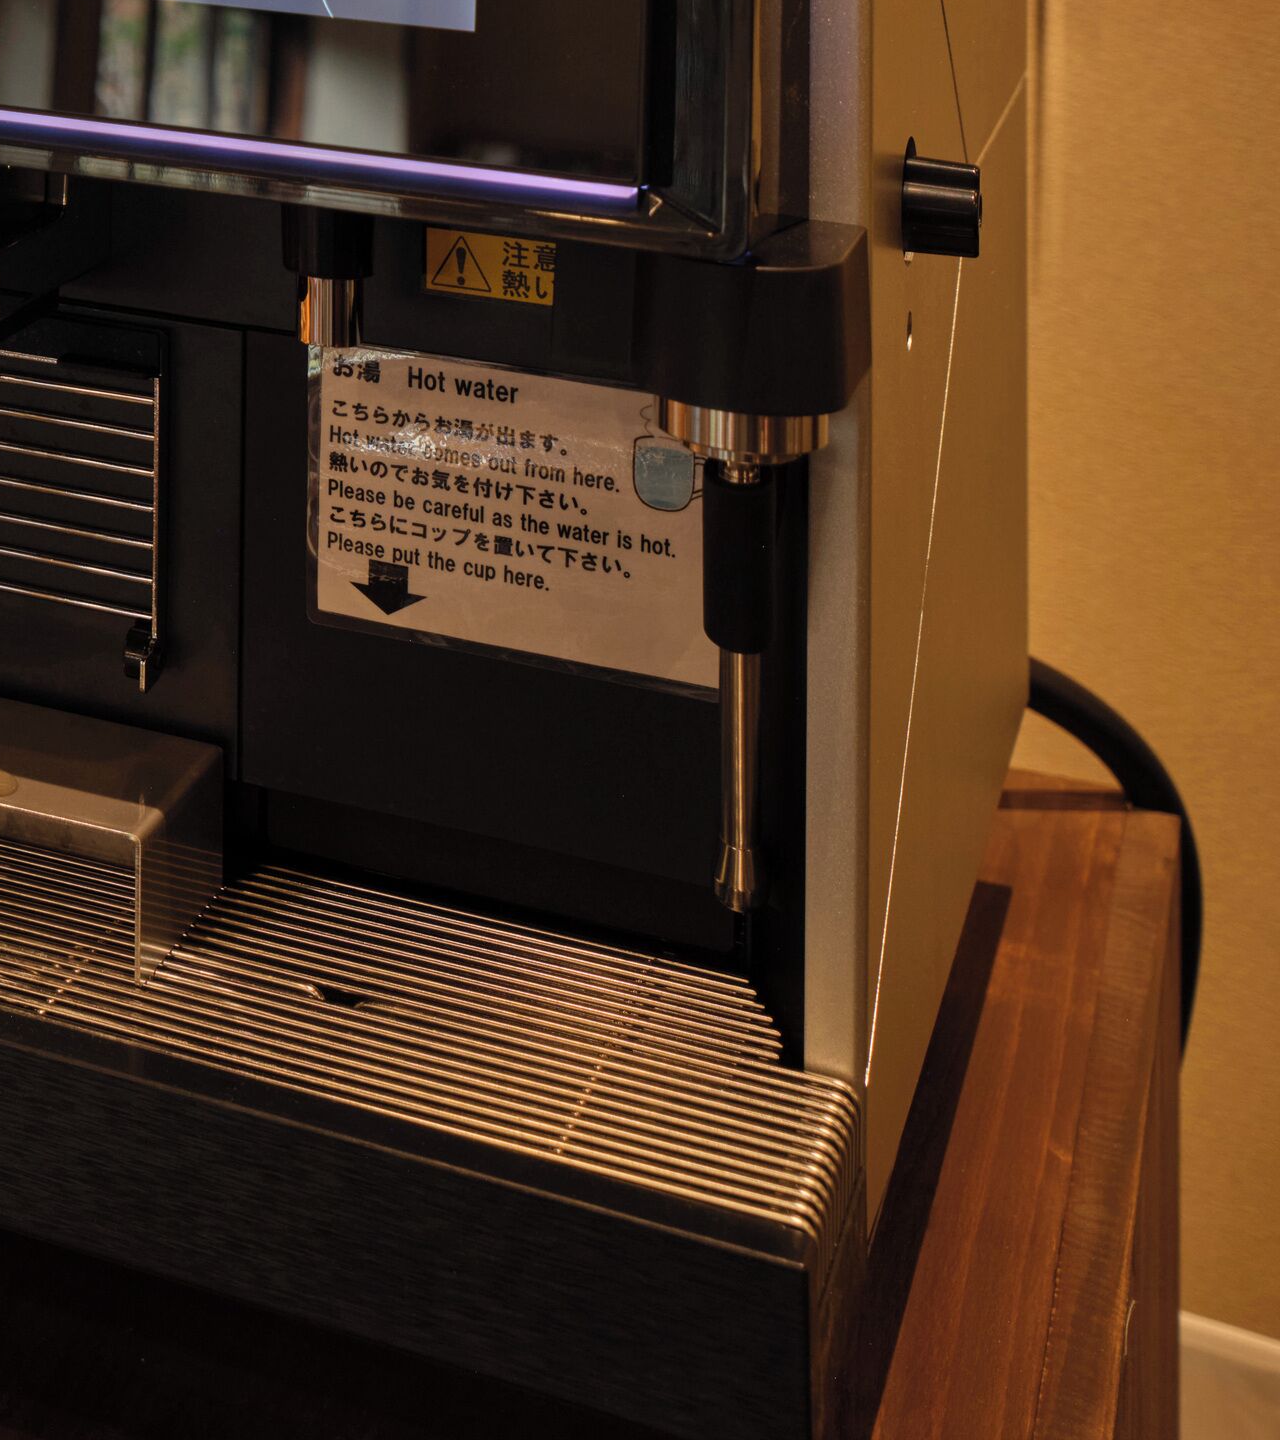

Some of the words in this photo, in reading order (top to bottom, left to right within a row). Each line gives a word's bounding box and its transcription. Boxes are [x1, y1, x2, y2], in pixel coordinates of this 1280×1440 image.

[502, 241, 556, 272] 注意
[332, 354, 381, 384] お湯
[407, 365, 445, 393] Hot
[455, 378, 519, 404] water
[329, 424, 359, 447] Hot
[423, 444, 481, 466] comes
[488, 456, 518, 475] out
[524, 458, 566, 483] from
[573, 466, 620, 493] here.
[332, 400, 567, 456] こちらからお湯が出ます。
[329, 451, 588, 516] 熱いのでお気を付け下さい。
[328, 478, 386, 505] Please
[393, 490, 415, 511] be
[423, 499, 485, 524] careful
[492, 511, 513, 529] as
[520, 513, 550, 535] the
[557, 522, 610, 546] water
[617, 530, 633, 550] is
[640, 533, 676, 558] hot.
[330, 506, 631, 579] こちらにコップを置いて下さい。
[327, 531, 385, 559] Please
[392, 546, 420, 566] put
[427, 551, 456, 573] the
[463, 561, 496, 581] cup
[504, 565, 550, 592] here.
